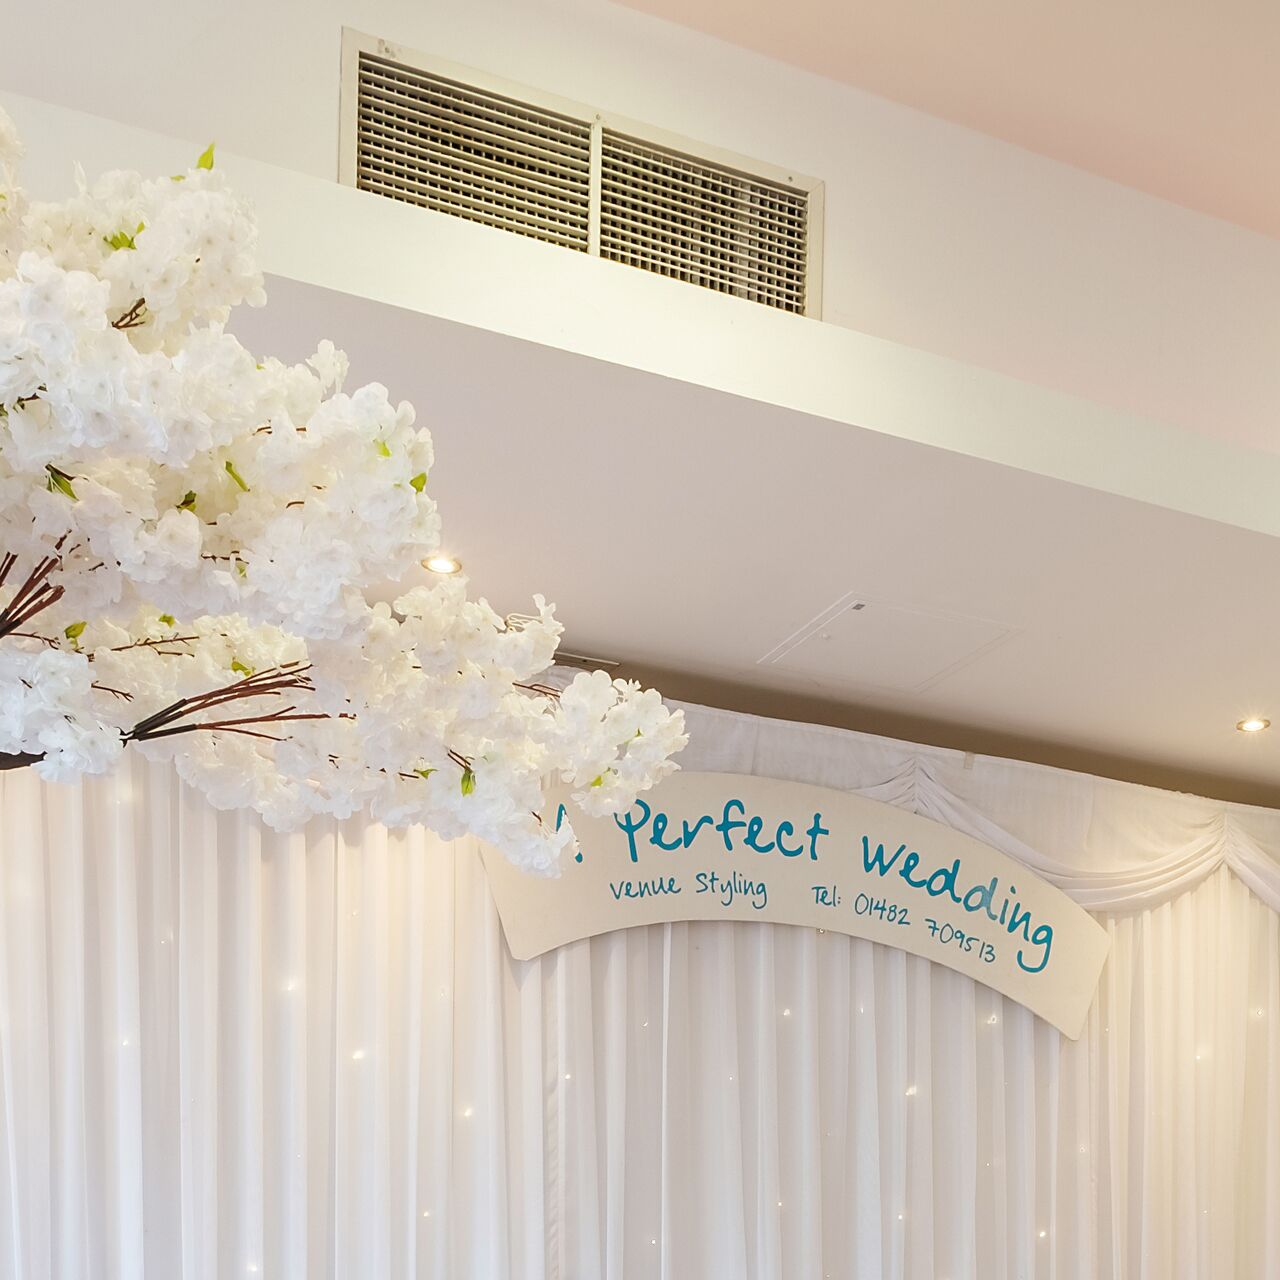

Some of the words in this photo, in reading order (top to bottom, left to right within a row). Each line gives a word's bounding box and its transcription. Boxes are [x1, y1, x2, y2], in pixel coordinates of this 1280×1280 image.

[811, 885, 842, 906] Tel:
[853, 892, 911, 926] 01482
[924, 918, 996, 963] 709513
